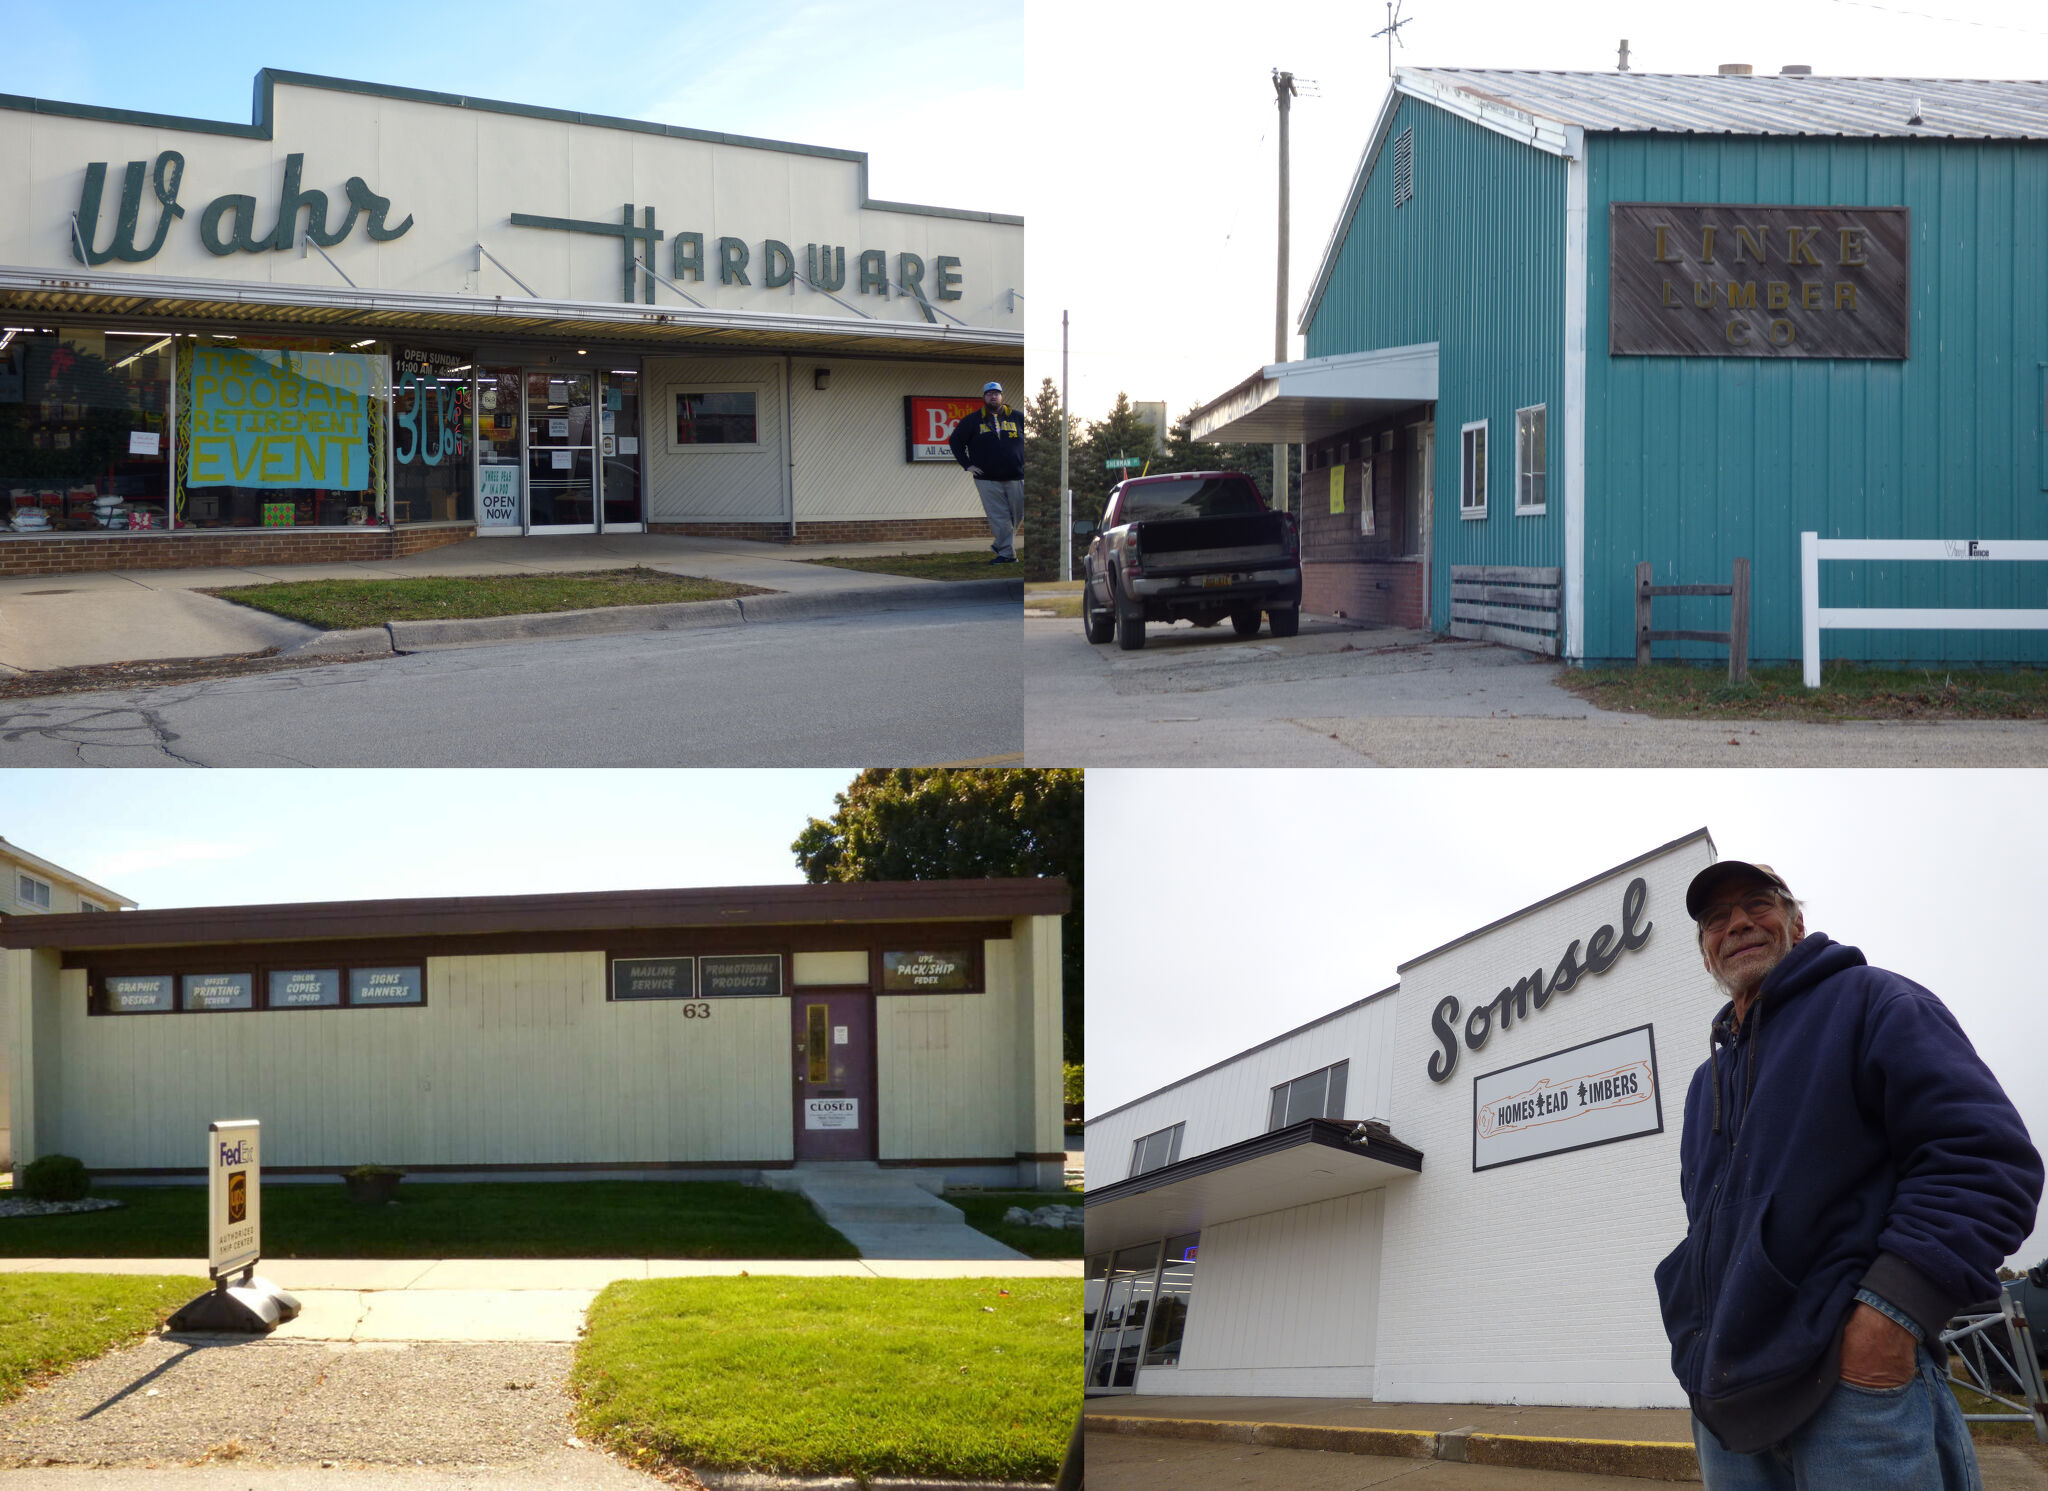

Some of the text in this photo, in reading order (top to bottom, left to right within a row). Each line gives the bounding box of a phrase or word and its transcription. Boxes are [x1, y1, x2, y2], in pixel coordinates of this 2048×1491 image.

[72, 150, 414, 266] Wahr
[1653, 223, 1869, 266] LINKE
[510, 203, 963, 324] HARDWARE
[1662, 280, 1857, 311] LUMBER
[404, 349, 461, 366] OPEN SUNDAY
[199, 352, 362, 387] THE GRAND
[396, 360, 418, 373] 11:00
[420, 363, 433, 375] AM
[195, 375, 359, 411] POOBAH
[193, 409, 362, 435] RETIREMENT
[925, 446, 936, 455] All
[191, 435, 362, 487] EVENT
[485, 470, 512, 482] THREE PEAS
[483, 496, 515, 507] OPEN
[486, 509, 512, 519] NOW
[918, 955, 934, 963] UPS
[630, 966, 677, 977] MAILING
[705, 963, 774, 975] PROMOTIONAL
[897, 963, 955, 975] PACK/SHIP
[204, 977, 229, 985] OFFSET
[292, 974, 316, 982] COLOR
[369, 974, 400, 985] SIGNS
[712, 976, 768, 988] PRODUCTS
[914, 976, 939, 984] FEDEX
[1428, 877, 1653, 1083] Somsel
[117, 982, 160, 992] GRAPHIC
[286, 982, 321, 993] COPIES
[631, 979, 675, 990] SERVICE
[193, 986, 240, 996] PRINTING
[361, 986, 409, 997] BANNERS
[121, 995, 156, 1005] DESIGN
[682, 1003, 711, 1019] 63
[810, 1103, 853, 1111] CLOSED
[220, 1140, 253, 1167] FedEx
[220, 1226, 253, 1244] AUTHORIZED
[234, 1236, 253, 1249] CENTER
